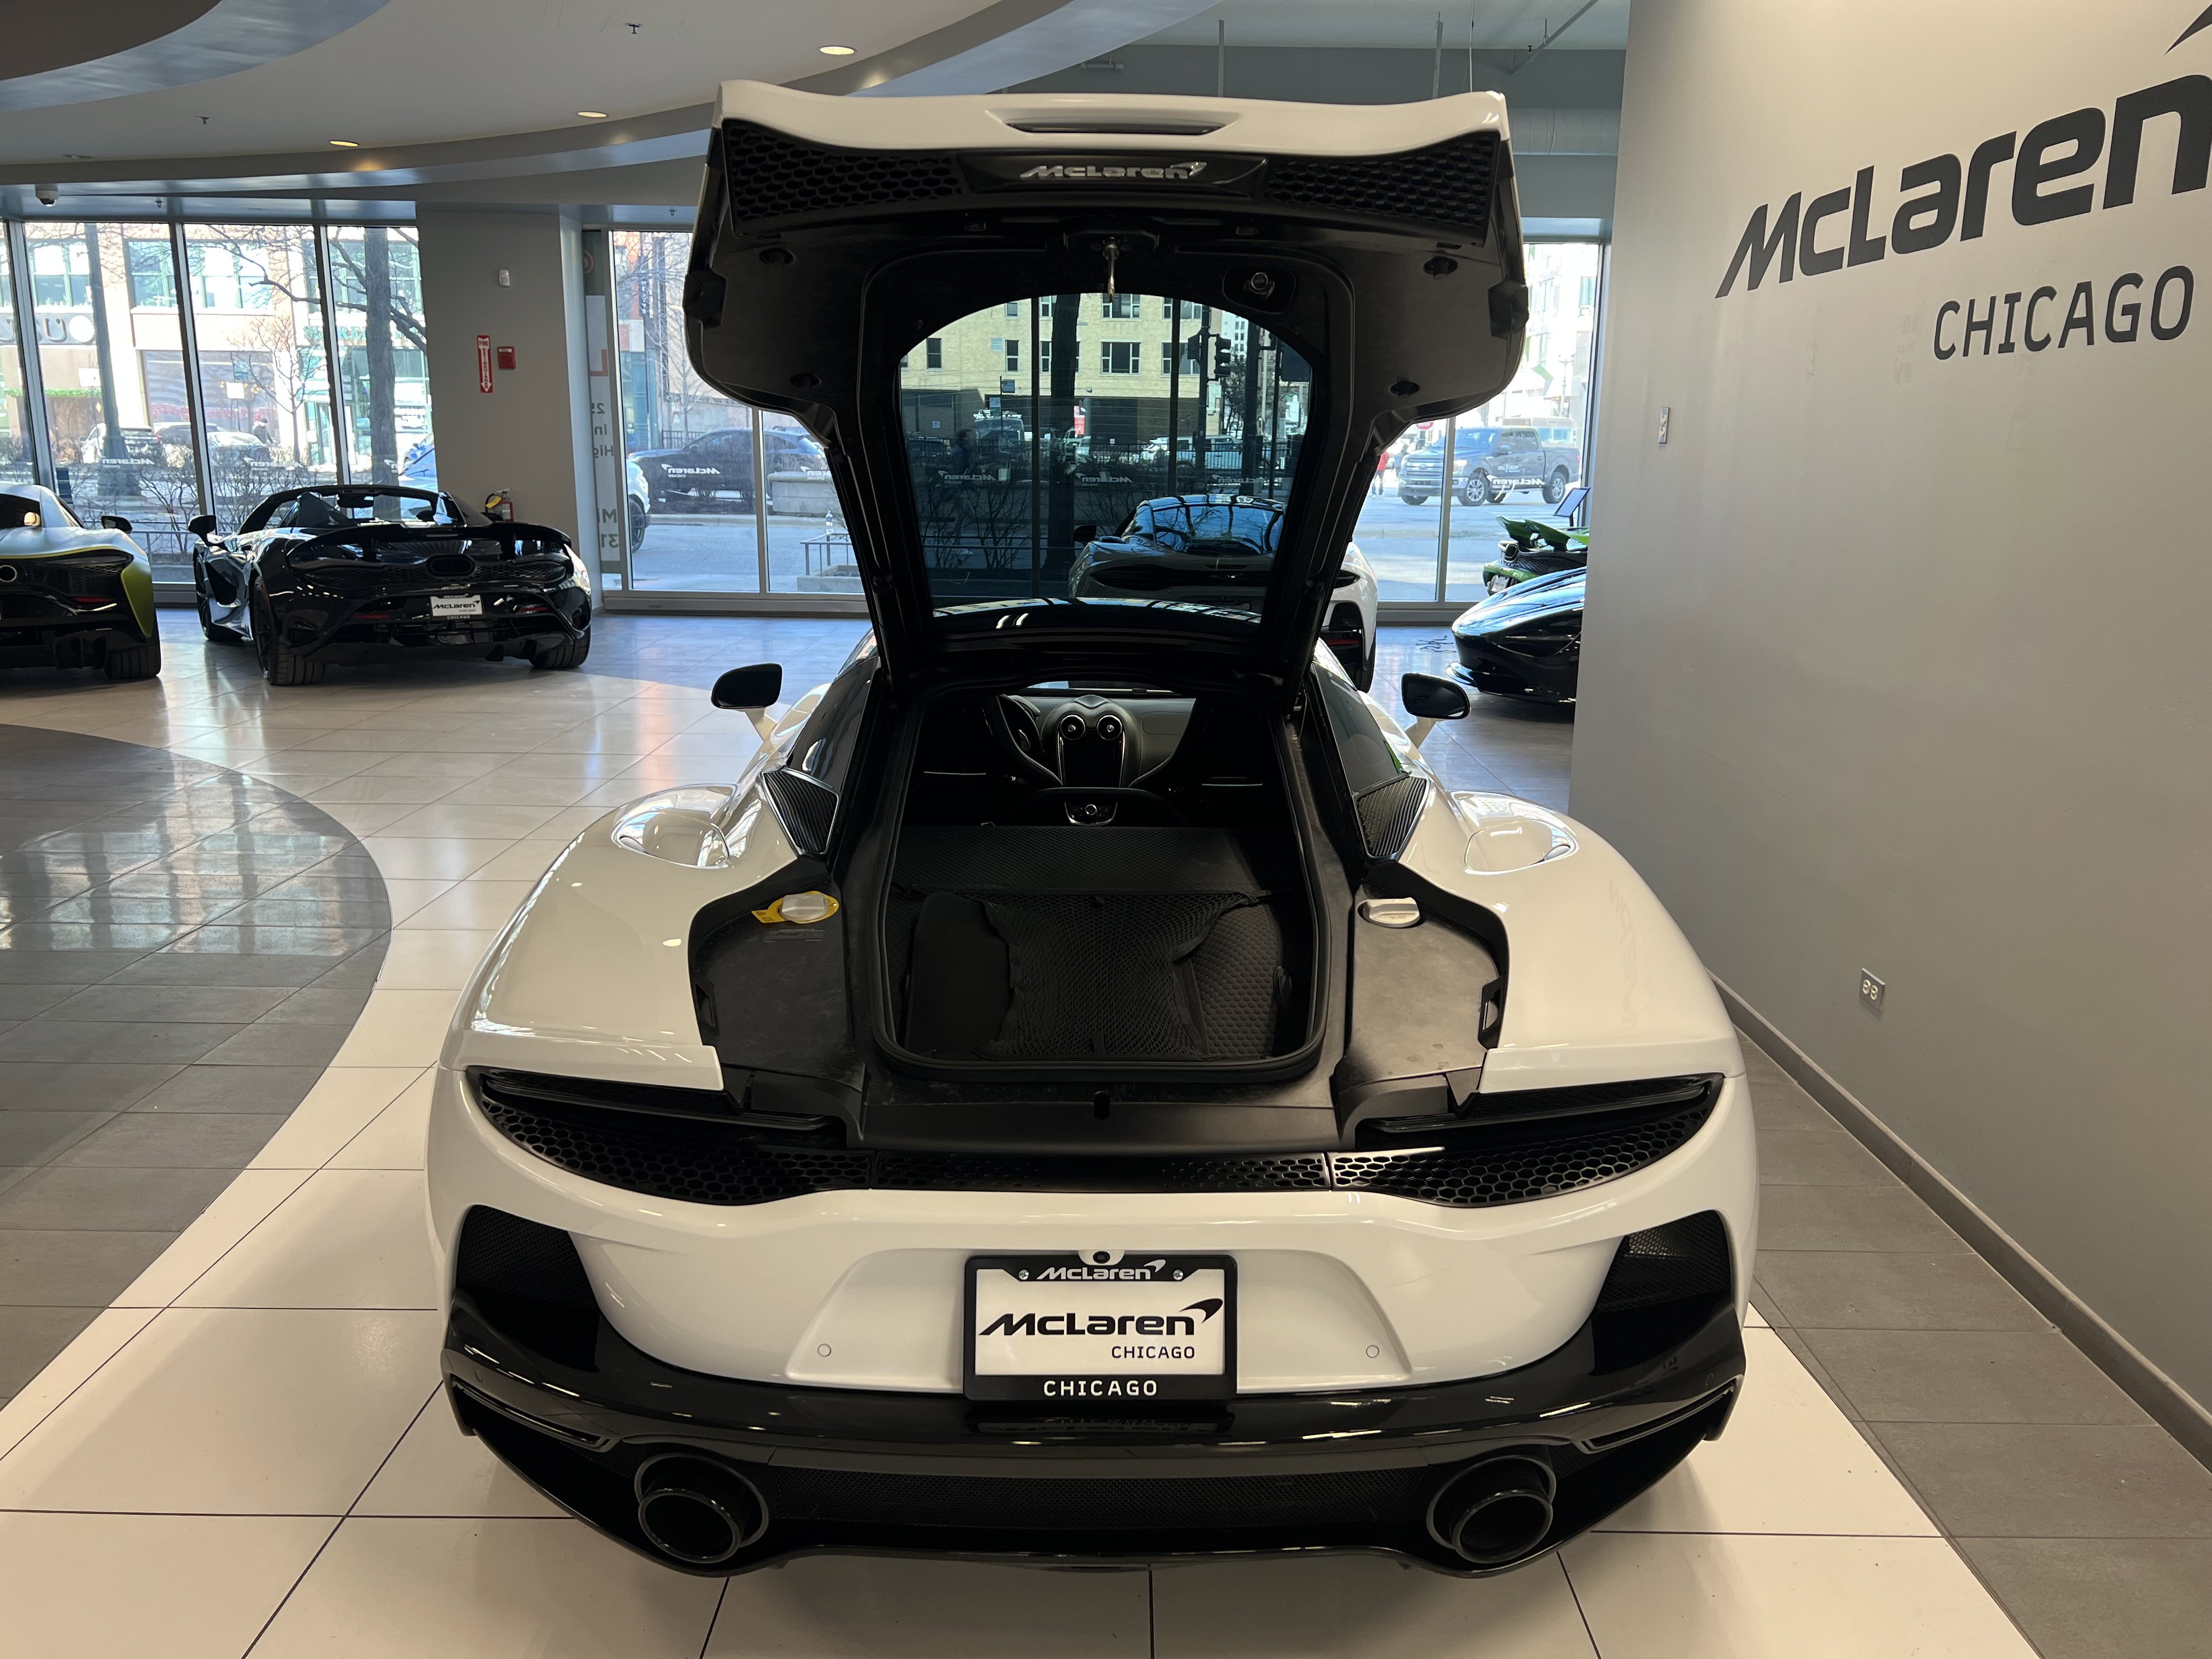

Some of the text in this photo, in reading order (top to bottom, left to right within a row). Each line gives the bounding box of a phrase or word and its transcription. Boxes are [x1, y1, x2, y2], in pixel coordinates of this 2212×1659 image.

[1019, 165, 1188, 180] McLaren
[1716, 74, 2212, 298] McLaren
[1934, 265, 2195, 360] CHICAGO
[1036, 1266, 1152, 1280] McLaren
[978, 1312, 1195, 1336] McLaren
[1111, 1345, 1195, 1359] CHICAGO
[1043, 1380, 1158, 1397] CHICAGO
